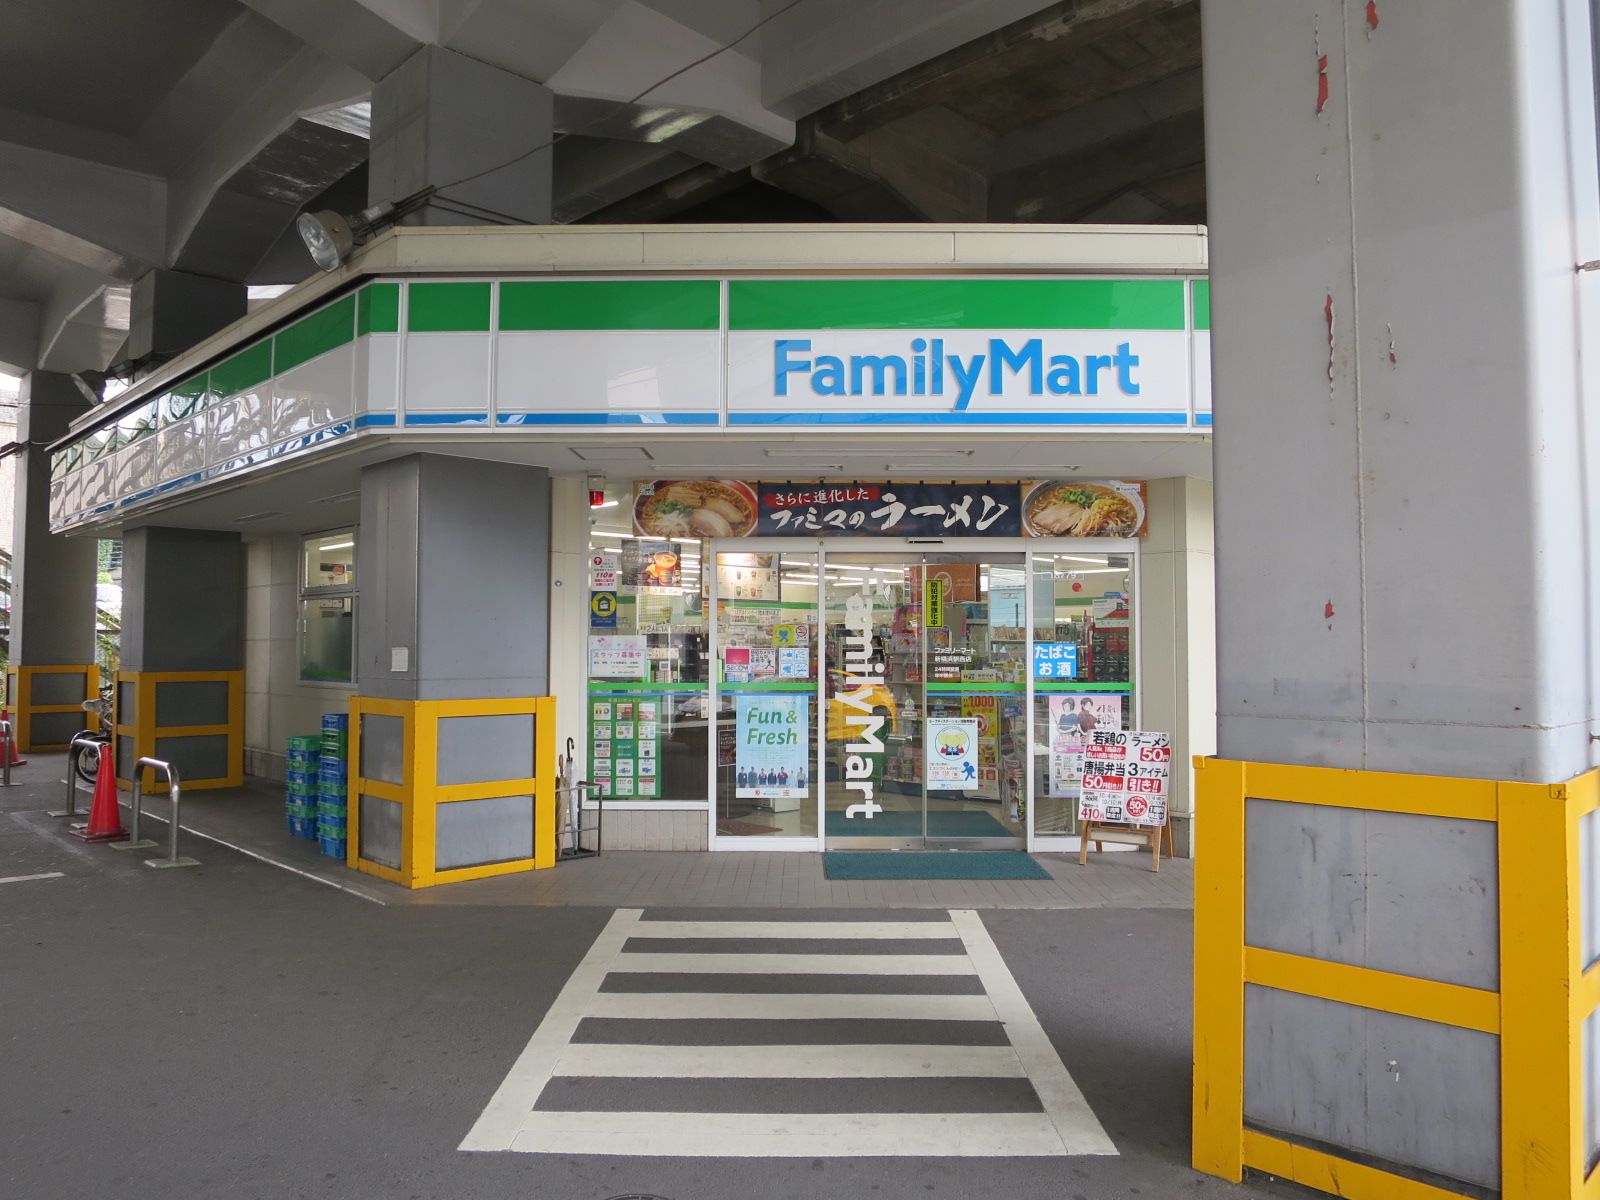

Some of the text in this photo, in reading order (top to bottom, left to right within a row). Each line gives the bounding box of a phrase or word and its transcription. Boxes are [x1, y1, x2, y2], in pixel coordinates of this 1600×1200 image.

[774, 337, 1140, 411] FamilyMart
[774, 487, 869, 506] さらに進化した
[1035, 644, 1076, 659] たばこ
[1039, 661, 1071, 676] お酒
[747, 707, 798, 724] Fun &
[747, 727, 798, 745] Fresh
[1092, 731, 1127, 746] 若鶏の
[1131, 736, 1169, 748] ラーメン
[1141, 748, 1169, 761] 50円
[1083, 761, 1125, 777] 唐揚弁当
